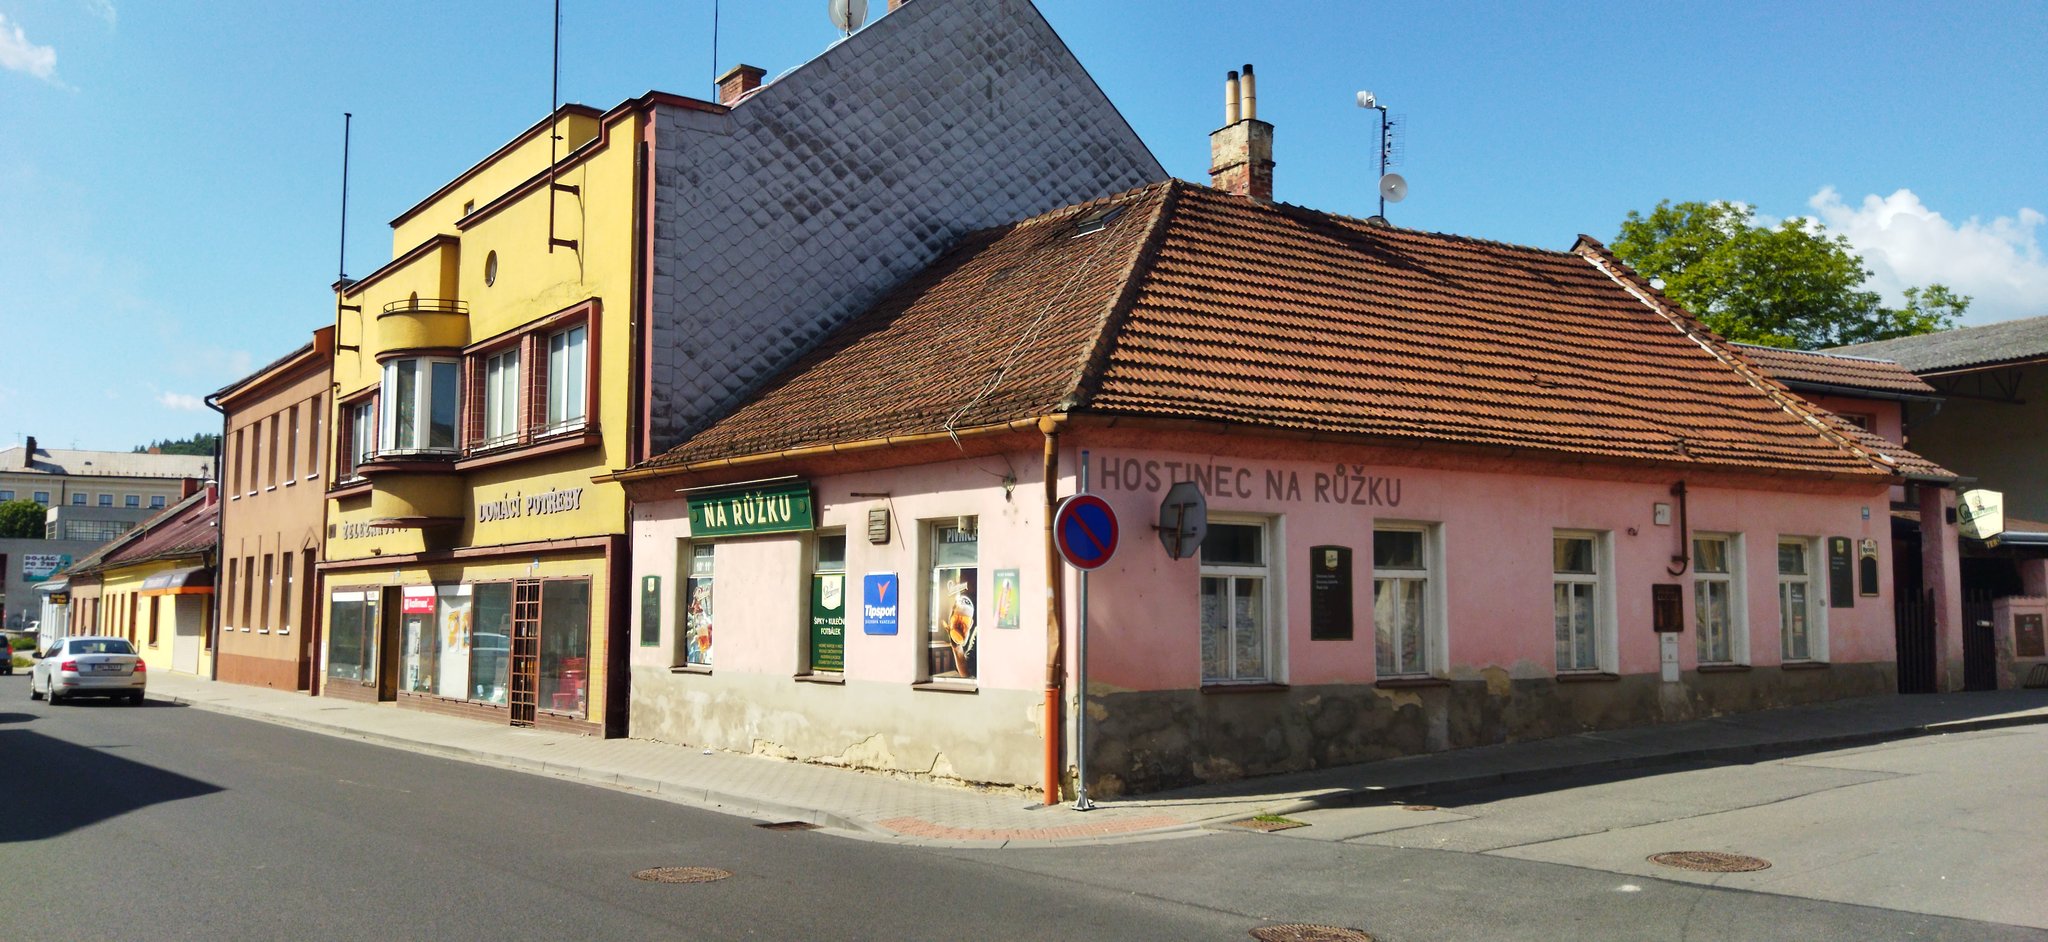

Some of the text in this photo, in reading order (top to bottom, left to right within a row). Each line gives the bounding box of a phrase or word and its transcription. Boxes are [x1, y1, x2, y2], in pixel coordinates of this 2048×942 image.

[1100, 456, 1400, 507] HOSTINEC NA RŮŽKU
[479, 488, 583, 523] DOMÁCÍ POTŘEBY
[704, 491, 791, 528] NA RŮŽKU
[865, 604, 896, 619] Tipsport
[820, 626, 841, 636] FOTBÁLEK
